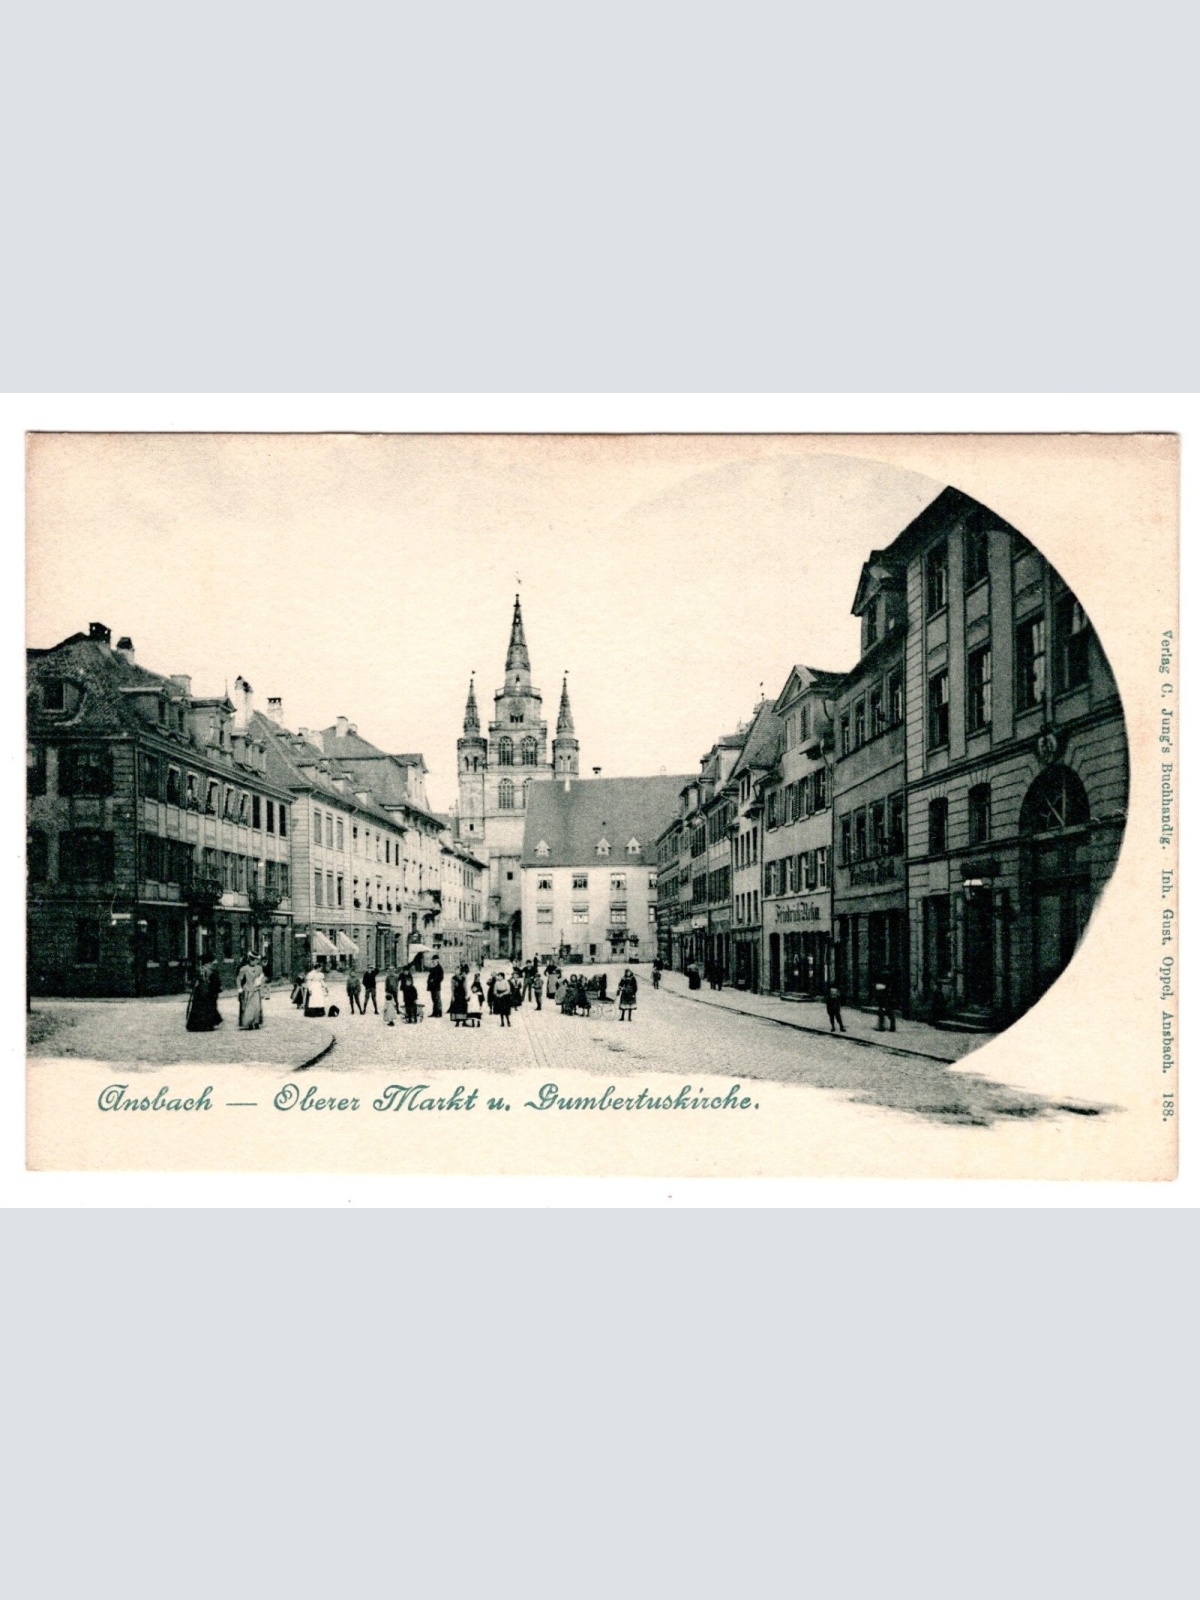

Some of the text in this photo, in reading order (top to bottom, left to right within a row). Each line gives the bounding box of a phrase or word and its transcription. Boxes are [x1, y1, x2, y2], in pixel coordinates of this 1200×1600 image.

[1159, 629, 1175, 1122] Verlag C. Jung's Buchhandlg. Inh. Gust. Oppel, Ansbach. 188.
[98, 1084, 214, 1112] Ansbach
[273, 1083, 361, 1112] Oberer
[372, 1084, 479, 1112] Markt
[487, 1097, 511, 1112] u.
[523, 1082, 760, 1111] Gumbertuskirche.
